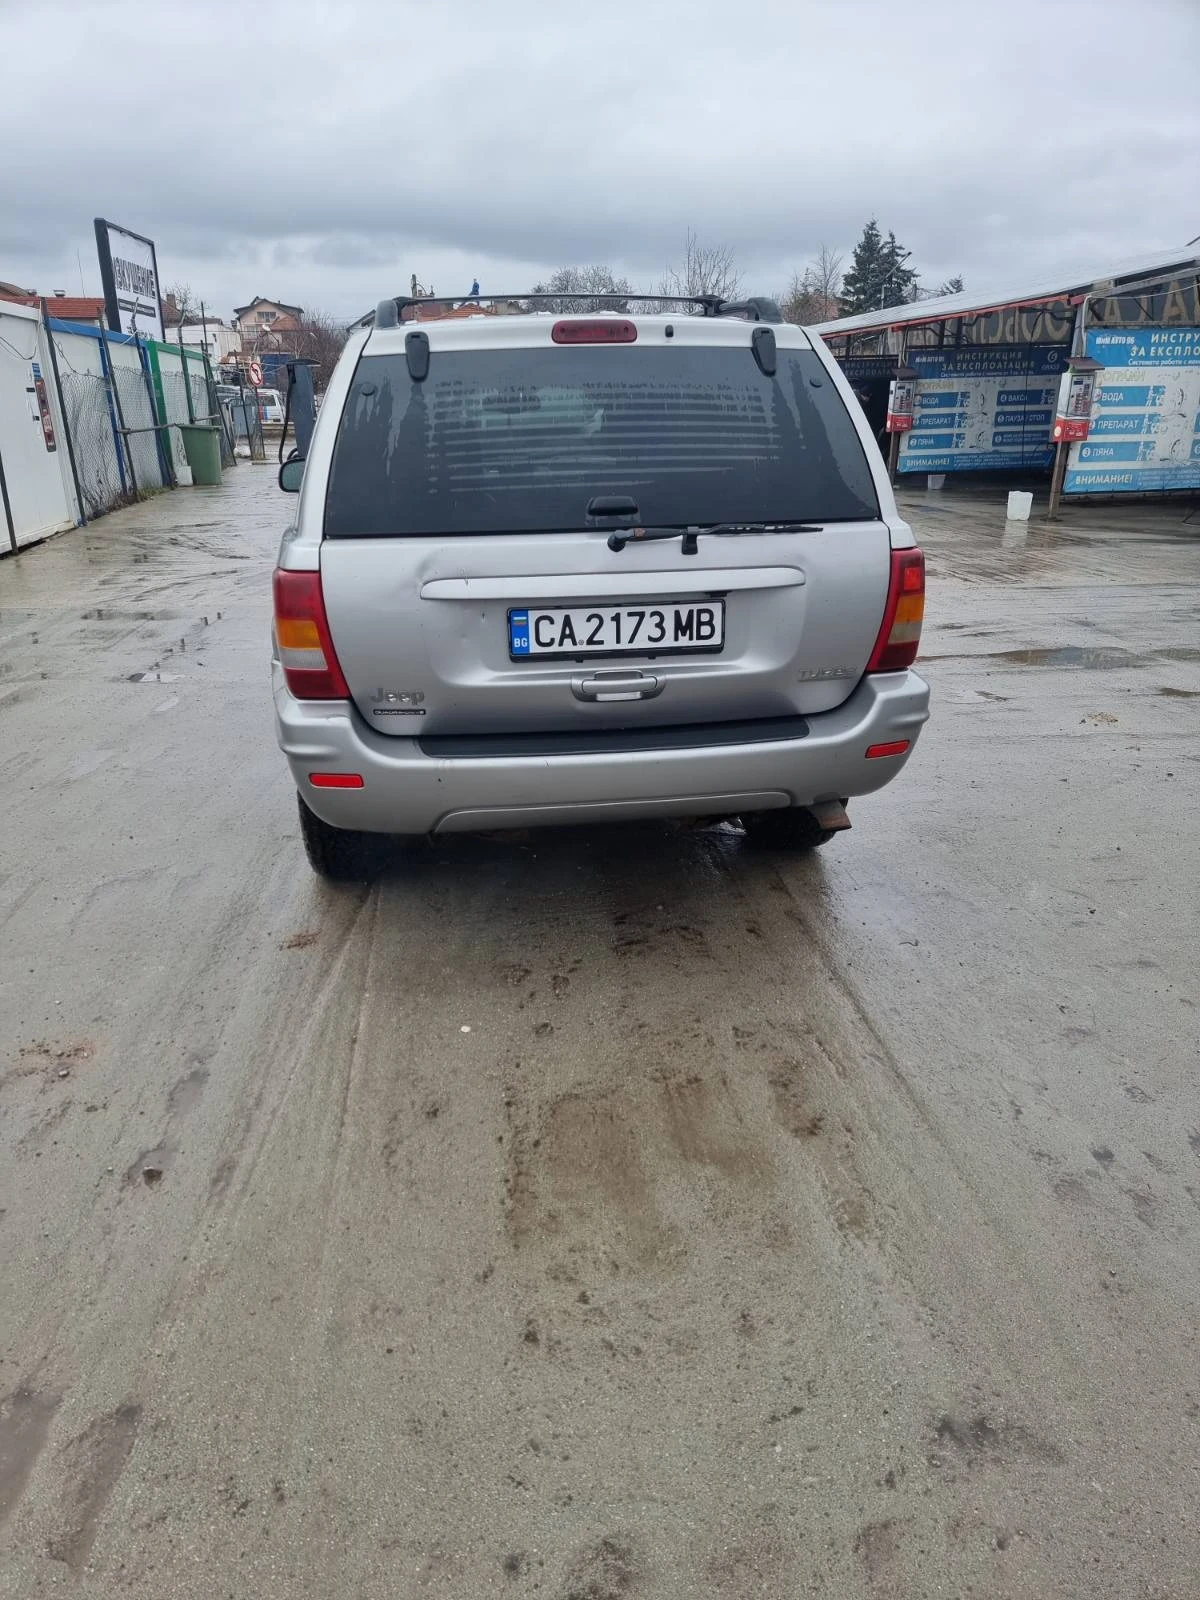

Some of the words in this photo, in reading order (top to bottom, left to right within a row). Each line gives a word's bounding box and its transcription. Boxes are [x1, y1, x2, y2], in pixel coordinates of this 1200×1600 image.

[1130, 346, 1146, 356] ЗА
[922, 397, 938, 405] ВОДА
[1102, 393, 1123, 401] ВОДА
[1097, 420, 1138, 429] ПРЕПАРАТ
[1092, 448, 1114, 456] ПЯНА
[1076, 475, 1133, 486] ВНИМАНИЕ!
[586, 610, 666, 646] 2173
[673, 607, 716, 642] MB
[513, 637, 527, 647] BG
[370, 687, 425, 705] Jeep
